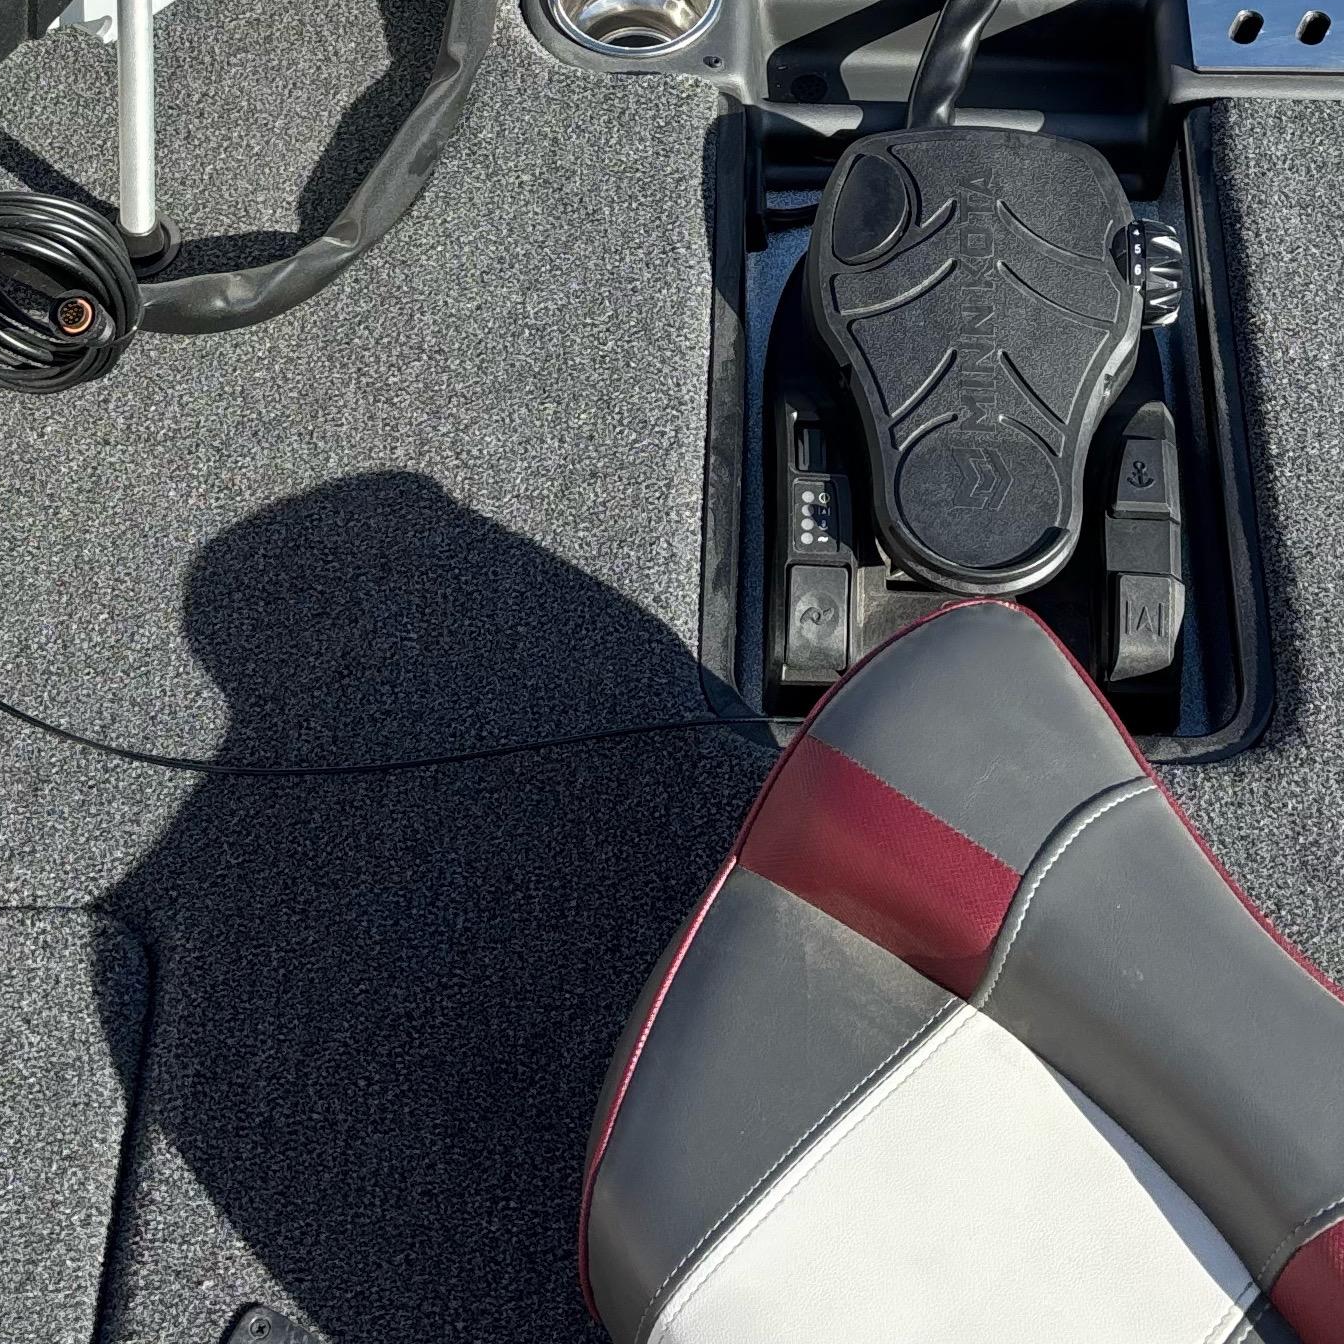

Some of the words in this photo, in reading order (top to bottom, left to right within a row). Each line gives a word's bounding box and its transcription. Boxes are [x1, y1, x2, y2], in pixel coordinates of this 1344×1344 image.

[958, 167, 997, 290] KOTA
[1134, 243, 1142, 255] 5
[1134, 263, 1142, 276] 6
[958, 307, 998, 433] MINN
